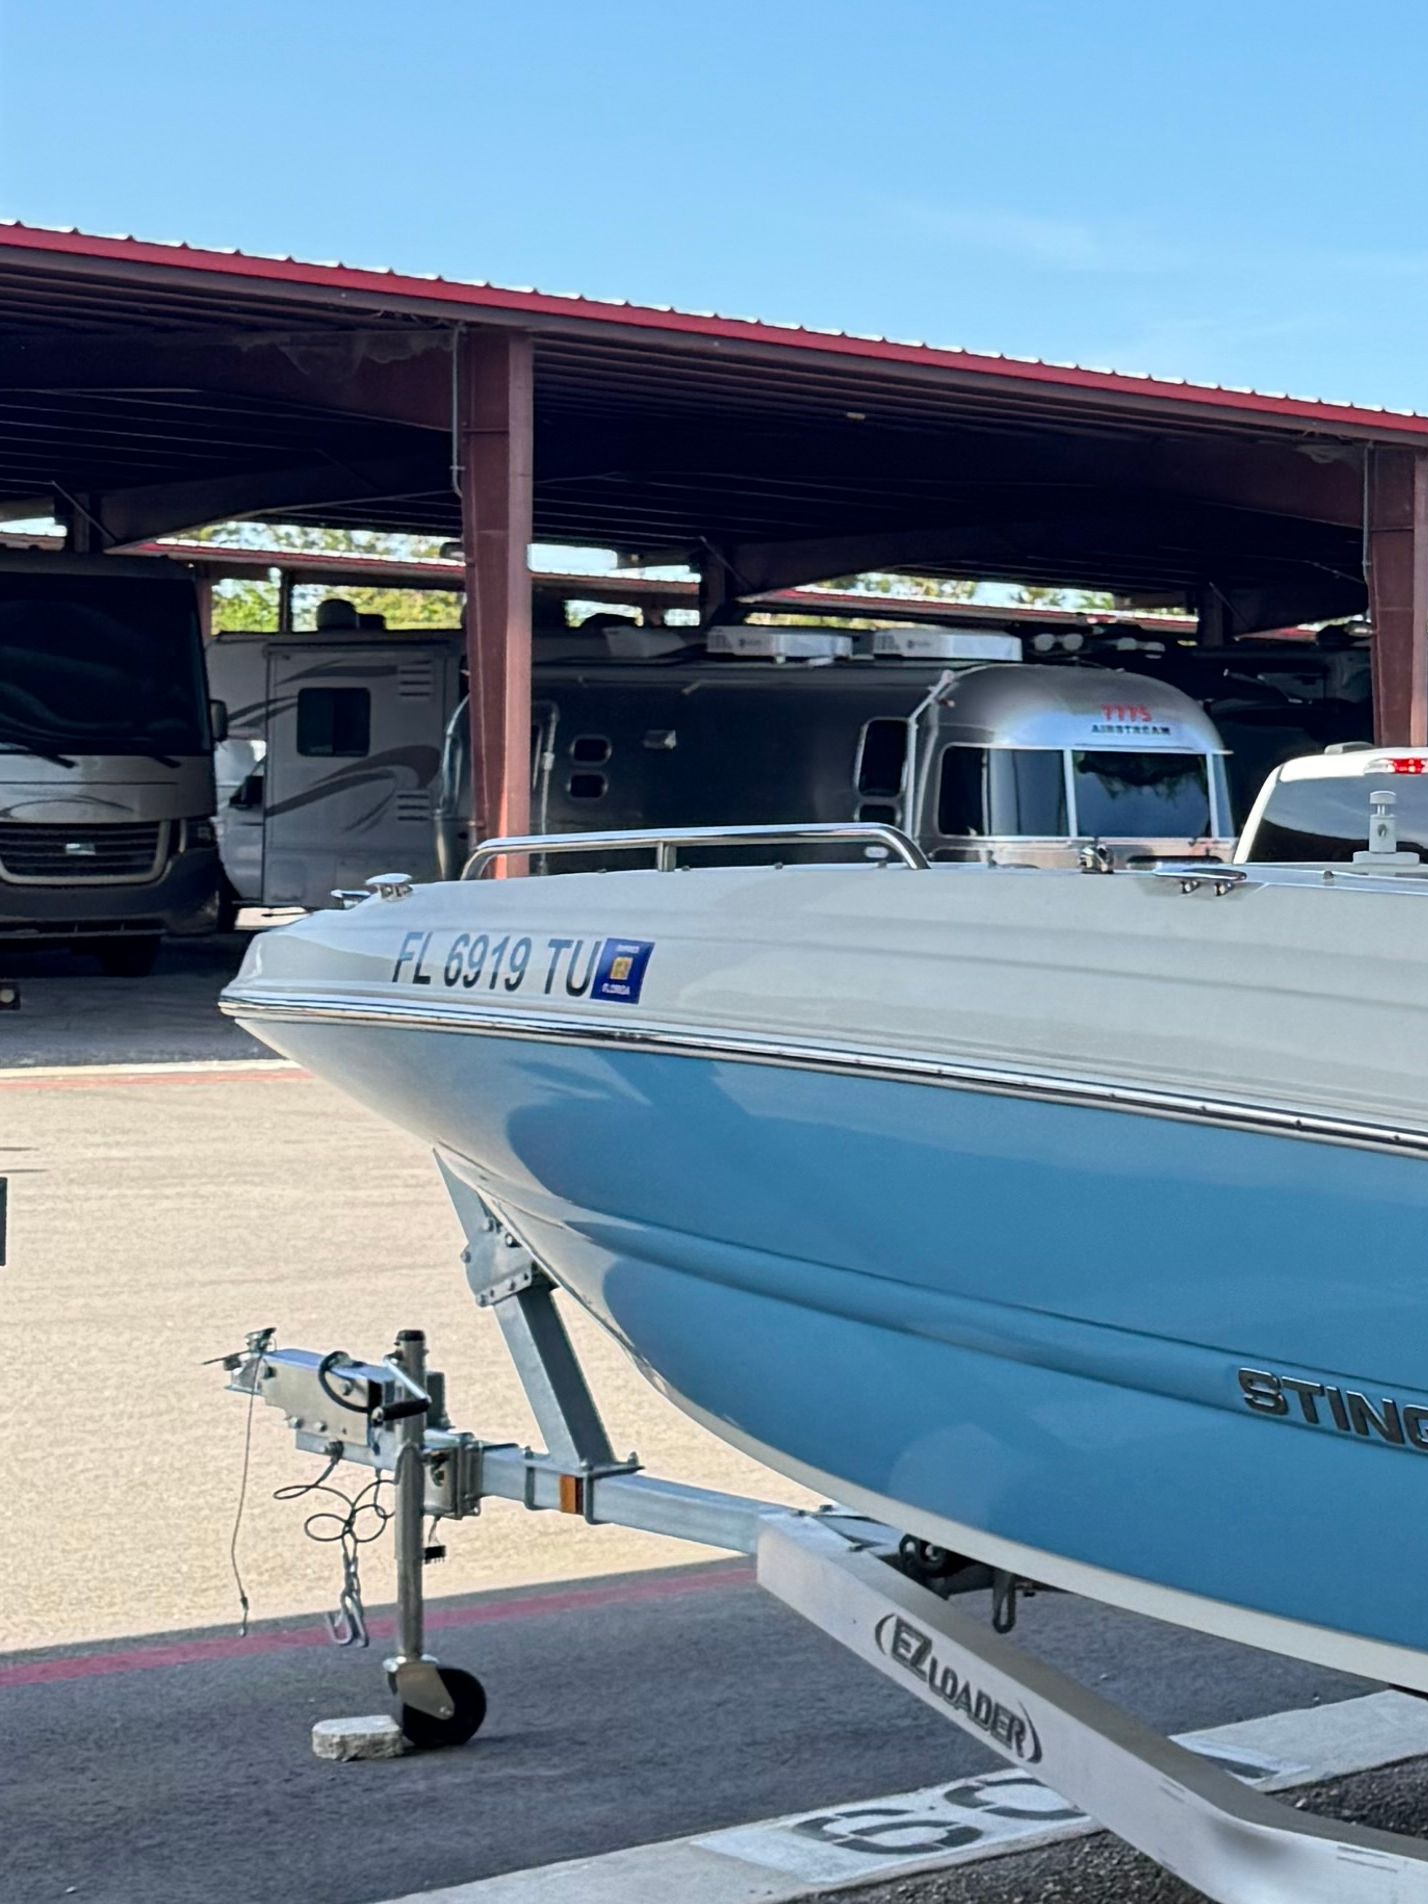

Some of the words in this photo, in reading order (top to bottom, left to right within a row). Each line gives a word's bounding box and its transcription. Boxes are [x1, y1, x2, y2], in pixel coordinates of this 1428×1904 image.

[392, 930, 434, 985] FL
[443, 933, 532, 993] 6919
[544, 939, 603, 997] TU
